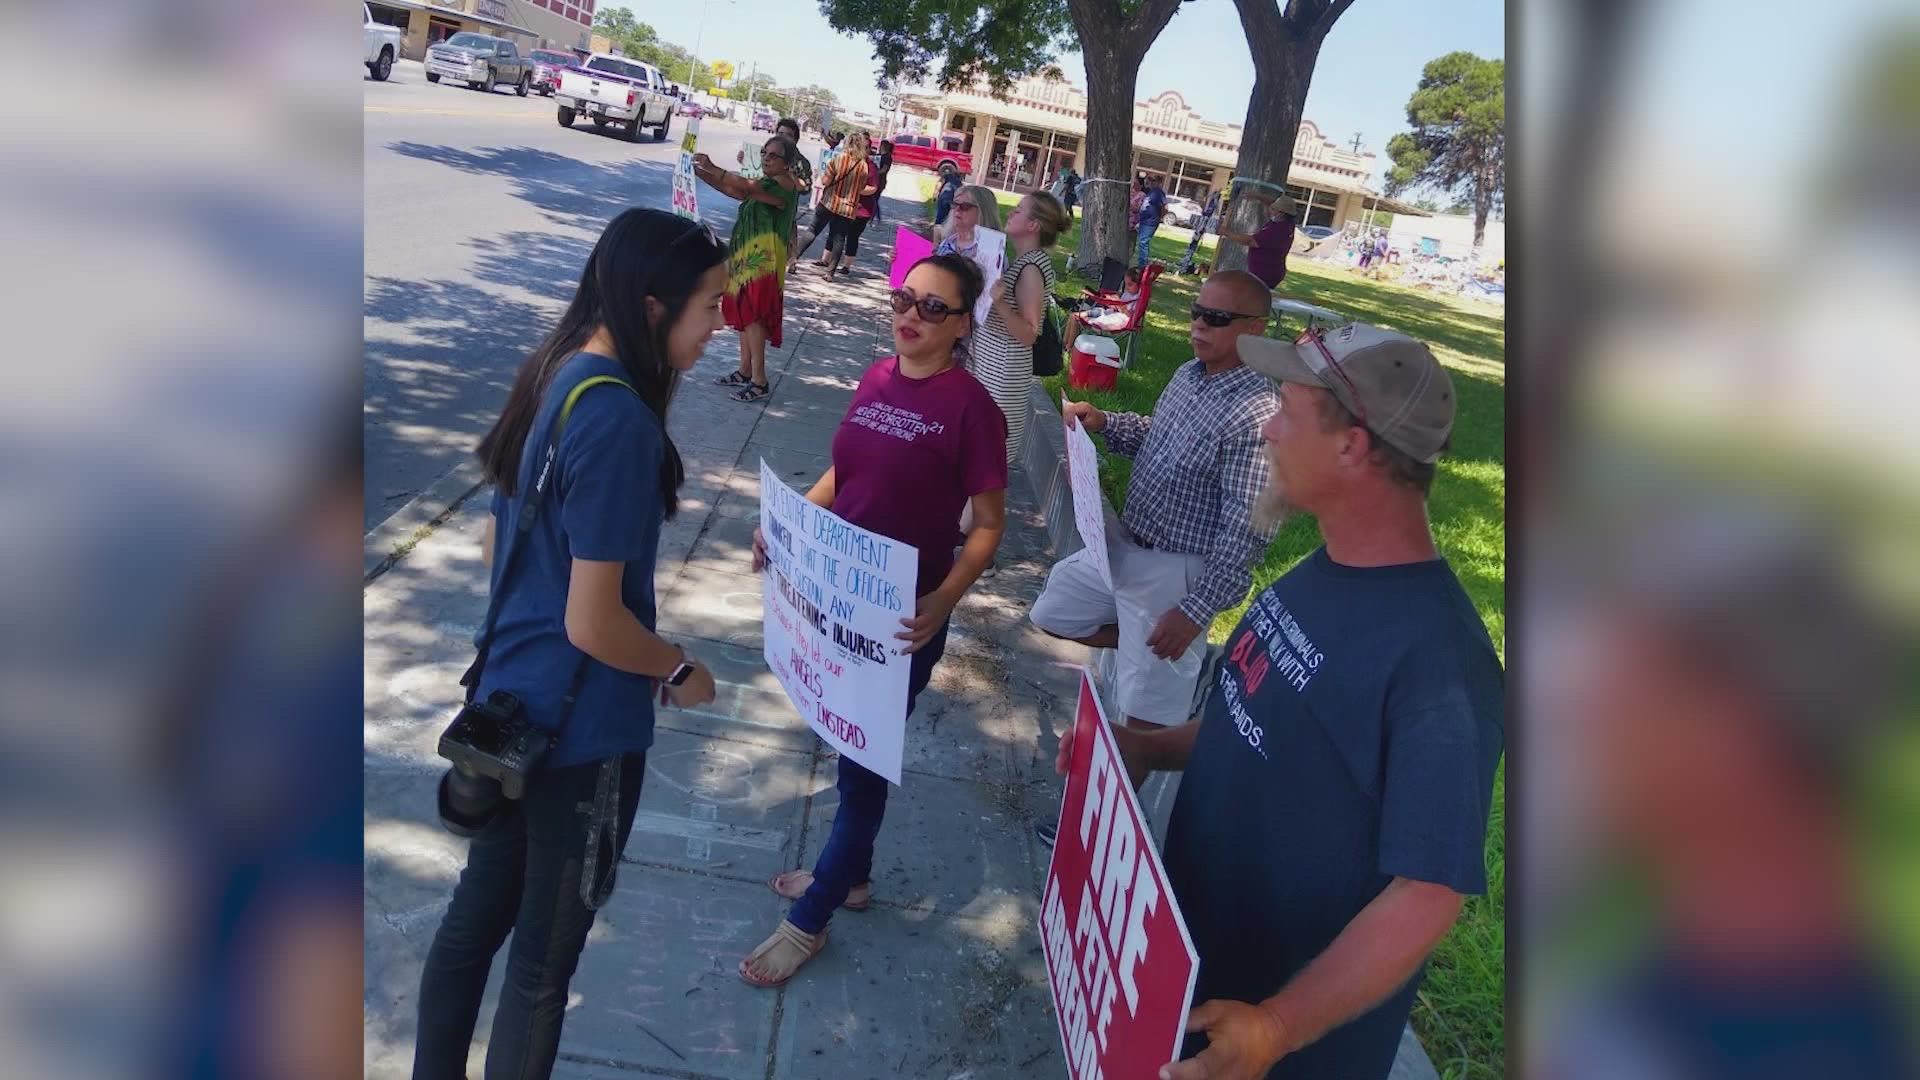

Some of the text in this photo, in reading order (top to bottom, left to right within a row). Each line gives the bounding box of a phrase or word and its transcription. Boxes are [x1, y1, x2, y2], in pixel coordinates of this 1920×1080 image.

[882, 96, 896, 107] 90
[856, 406, 944, 435] NEVER FORGOTTEN 21
[888, 426, 916, 442] STRONG
[893, 408, 923, 420] STRONG
[813, 510, 892, 571] DEPARTMENT
[776, 568, 827, 637] THREATENING
[799, 537, 816, 573] THAT
[822, 553, 840, 588] THE
[846, 566, 902, 612] OFFICERS
[829, 594, 856, 623] ANY
[790, 647, 824, 699] ANGELS
[795, 618, 809, 657] they
[824, 657, 845, 679] our
[1276, 649, 1313, 692] WITH
[1080, 724, 1159, 1019] FIRE
[1043, 873, 1104, 1080] ARREDO
[1075, 879, 1118, 1054] PETE
